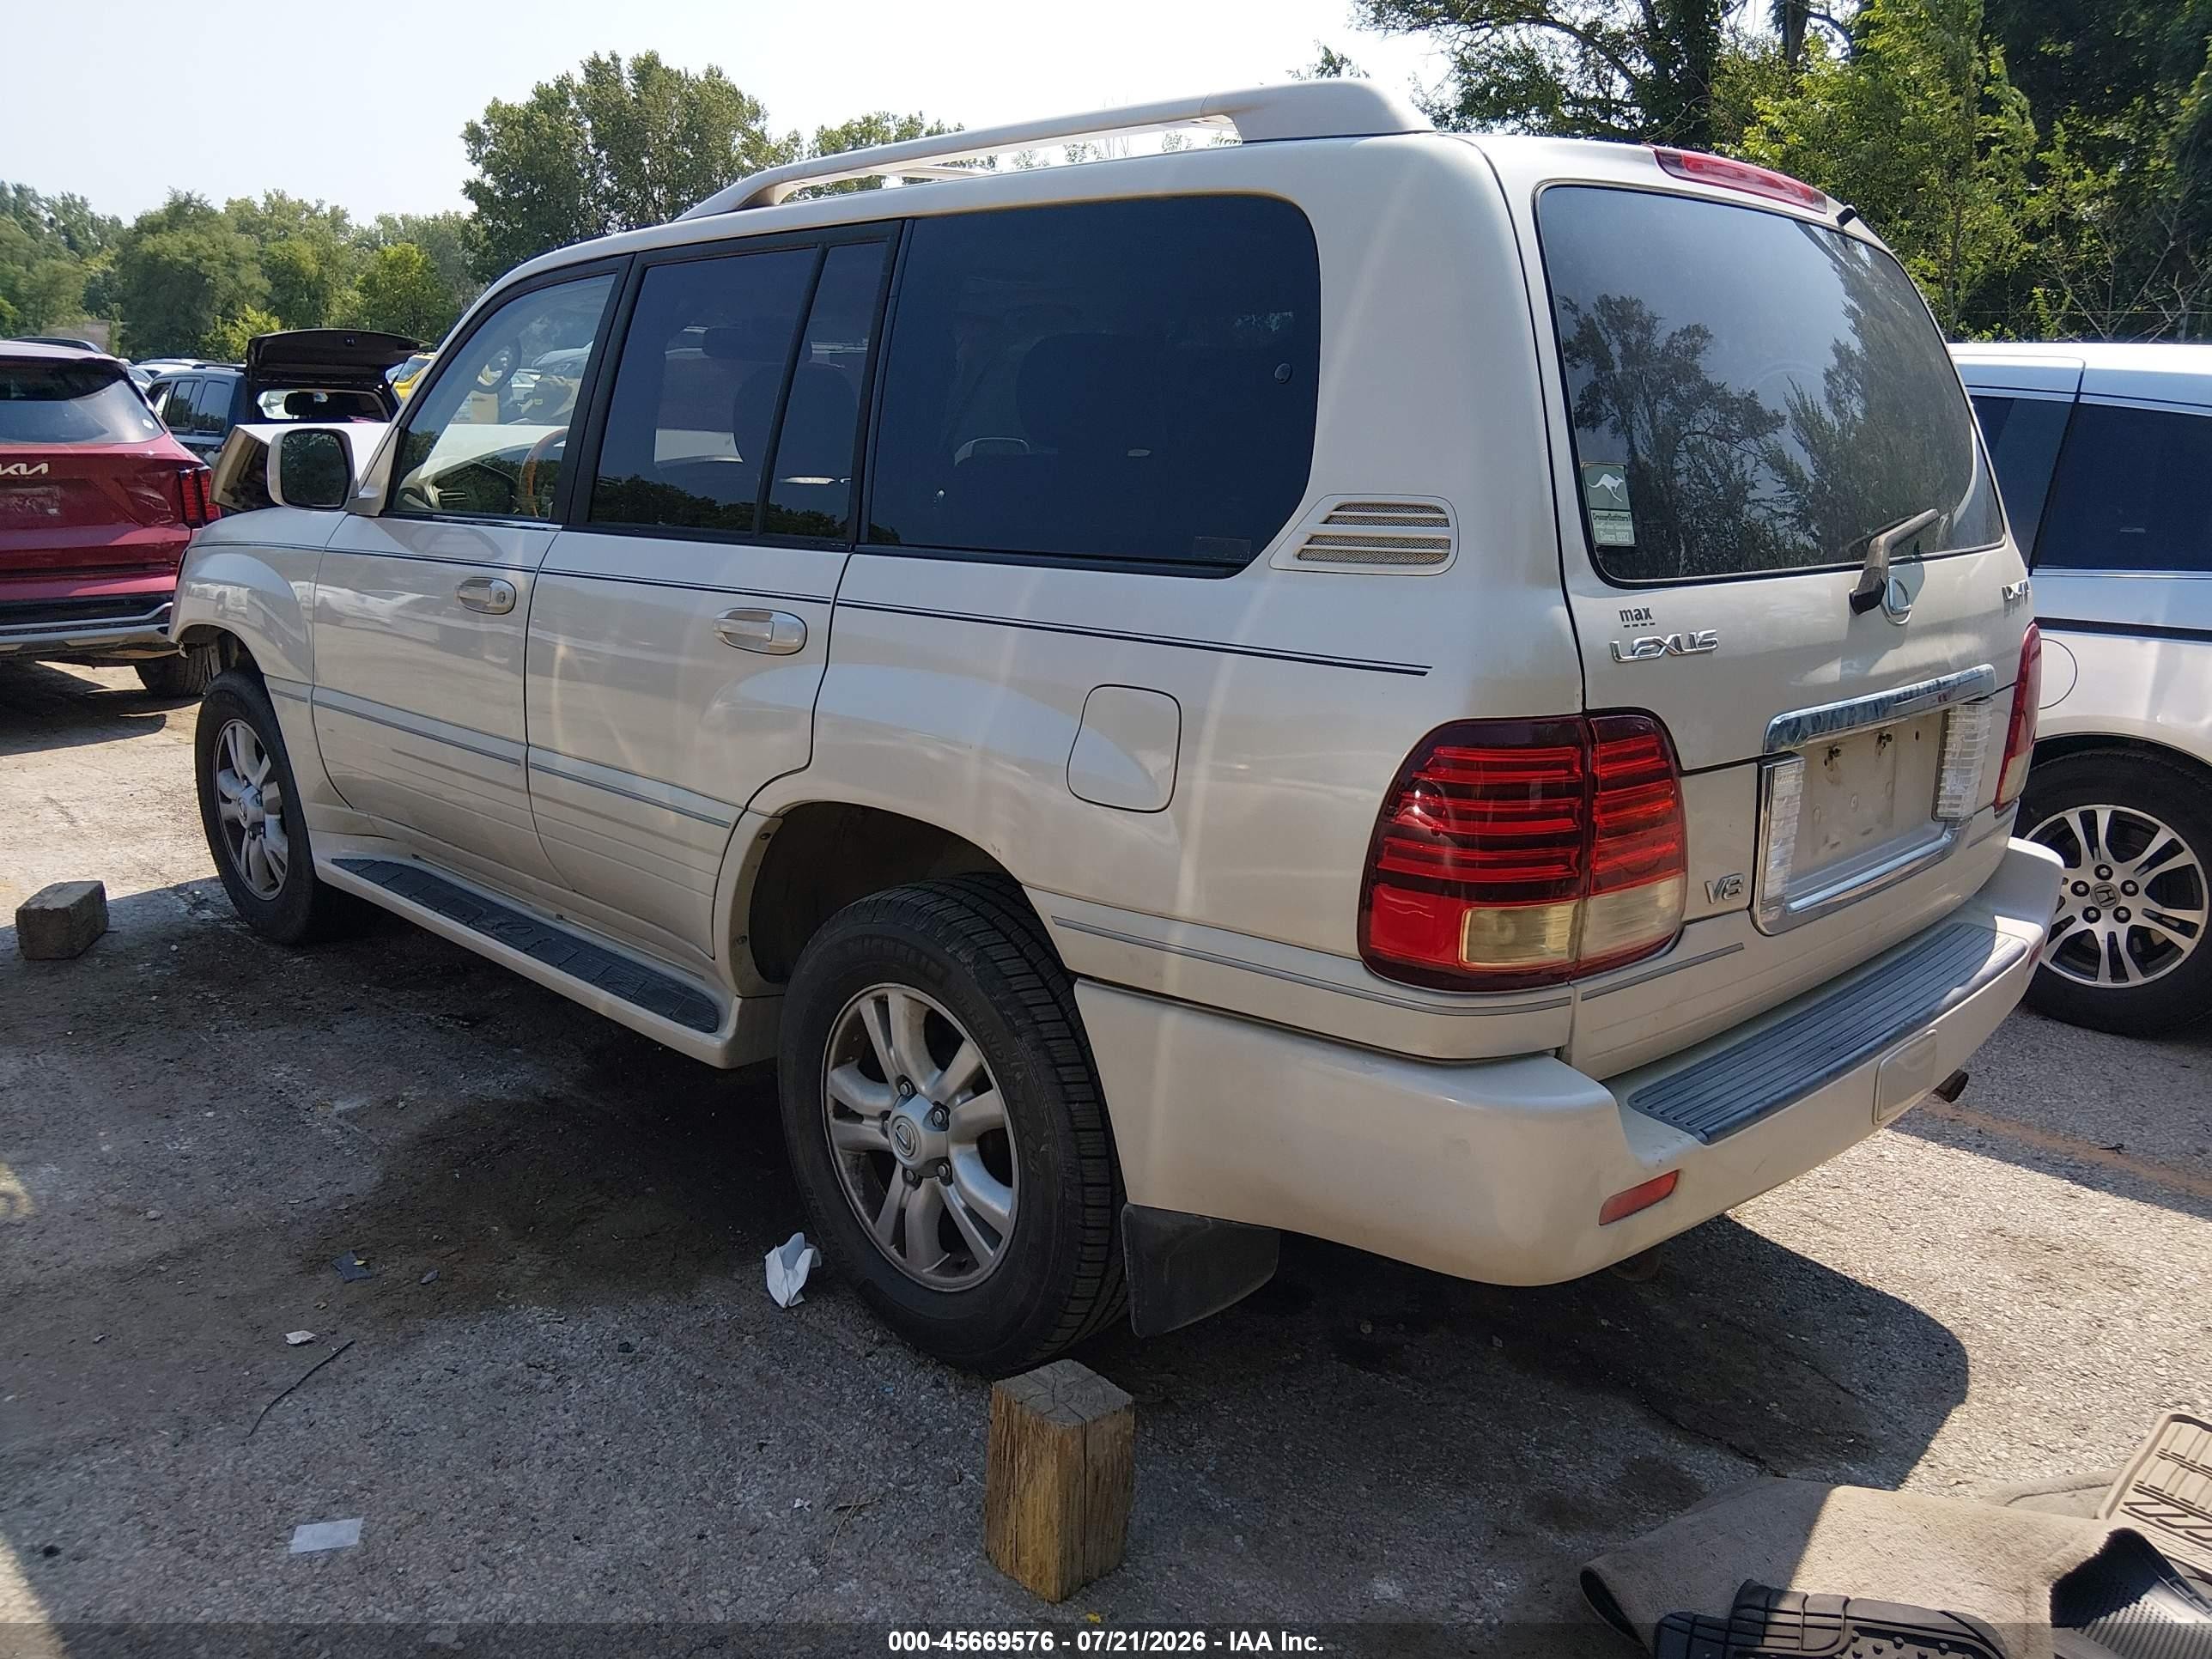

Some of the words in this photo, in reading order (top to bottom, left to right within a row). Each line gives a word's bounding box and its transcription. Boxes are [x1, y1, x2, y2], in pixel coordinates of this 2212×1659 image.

[1619, 606, 1653, 623] max
[1609, 629, 1718, 663] LEXUS
[1704, 872, 1745, 904] V8
